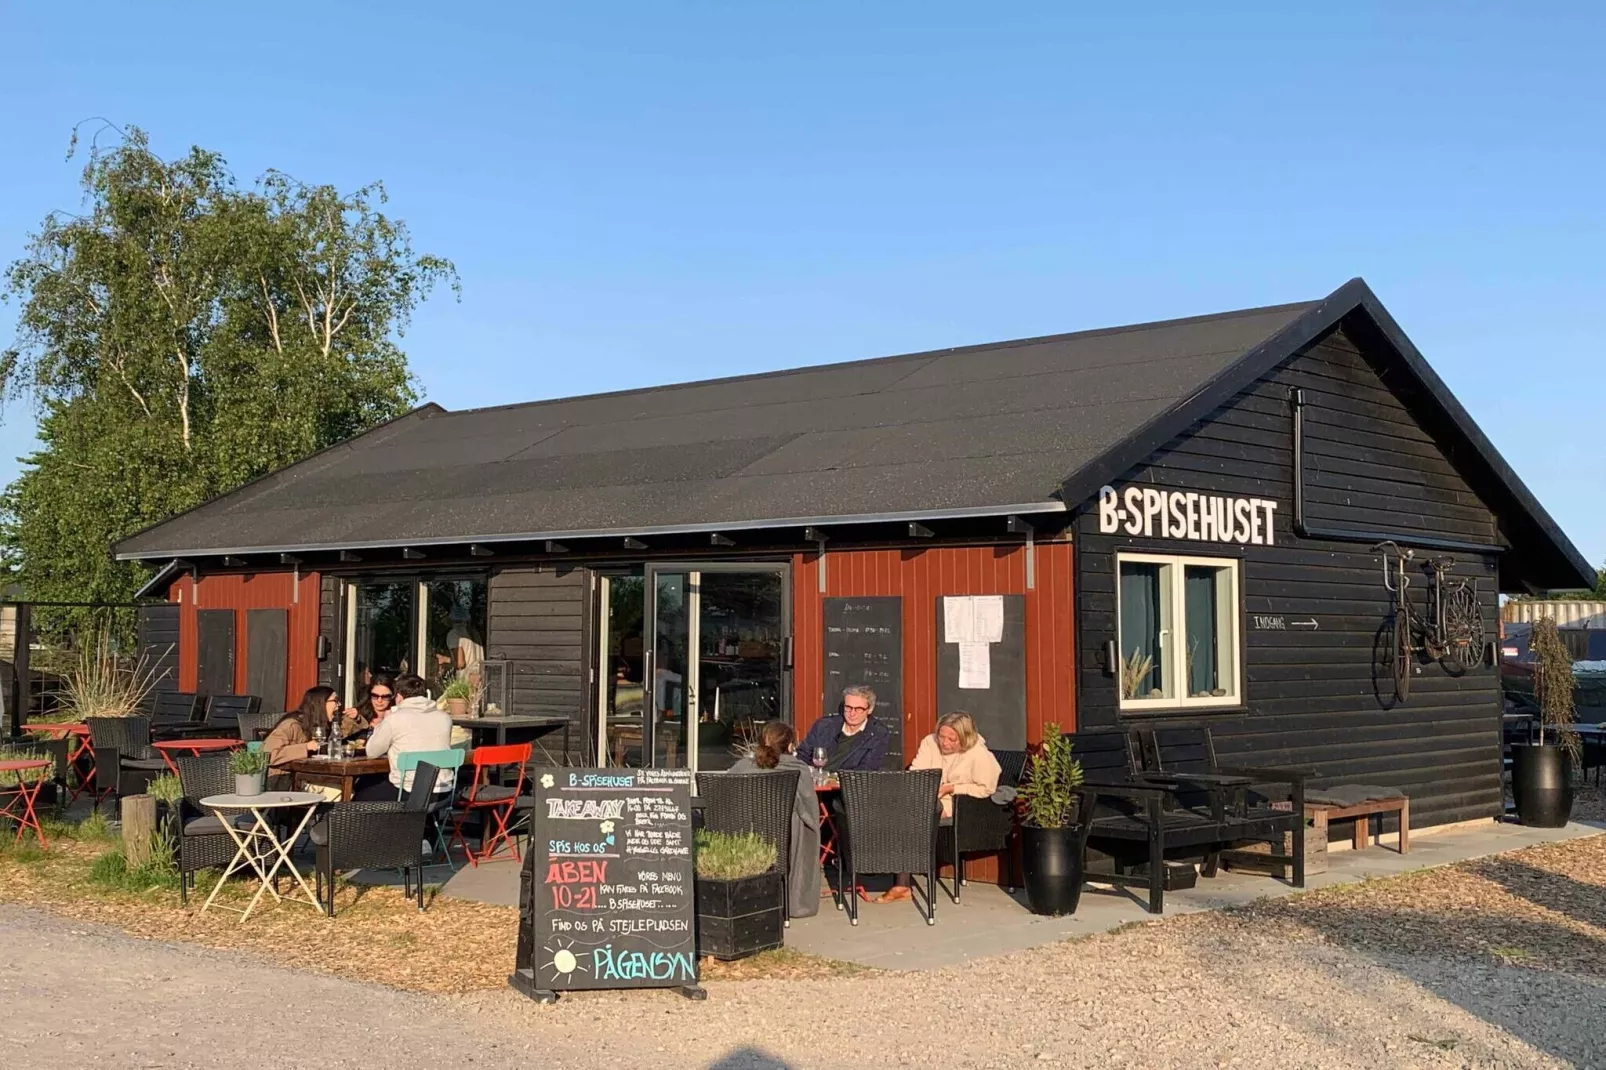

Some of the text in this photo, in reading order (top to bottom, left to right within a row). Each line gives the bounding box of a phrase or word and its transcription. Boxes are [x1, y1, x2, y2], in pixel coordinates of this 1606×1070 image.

[1100, 485, 1277, 545] B-SPISEHUSET
[545, 798, 625, 820] TAKEAWAY
[574, 842, 590, 853] HOS
[593, 842, 607, 854] OS
[545, 858, 608, 884] ÅBEN
[638, 870, 682, 882] VORES MENU
[600, 884, 615, 895] KAN
[640, 882, 649, 894] PÅ
[652, 883, 683, 896] FACEBOOK
[574, 919, 588, 931] OS
[592, 917, 605, 932] PÅ
